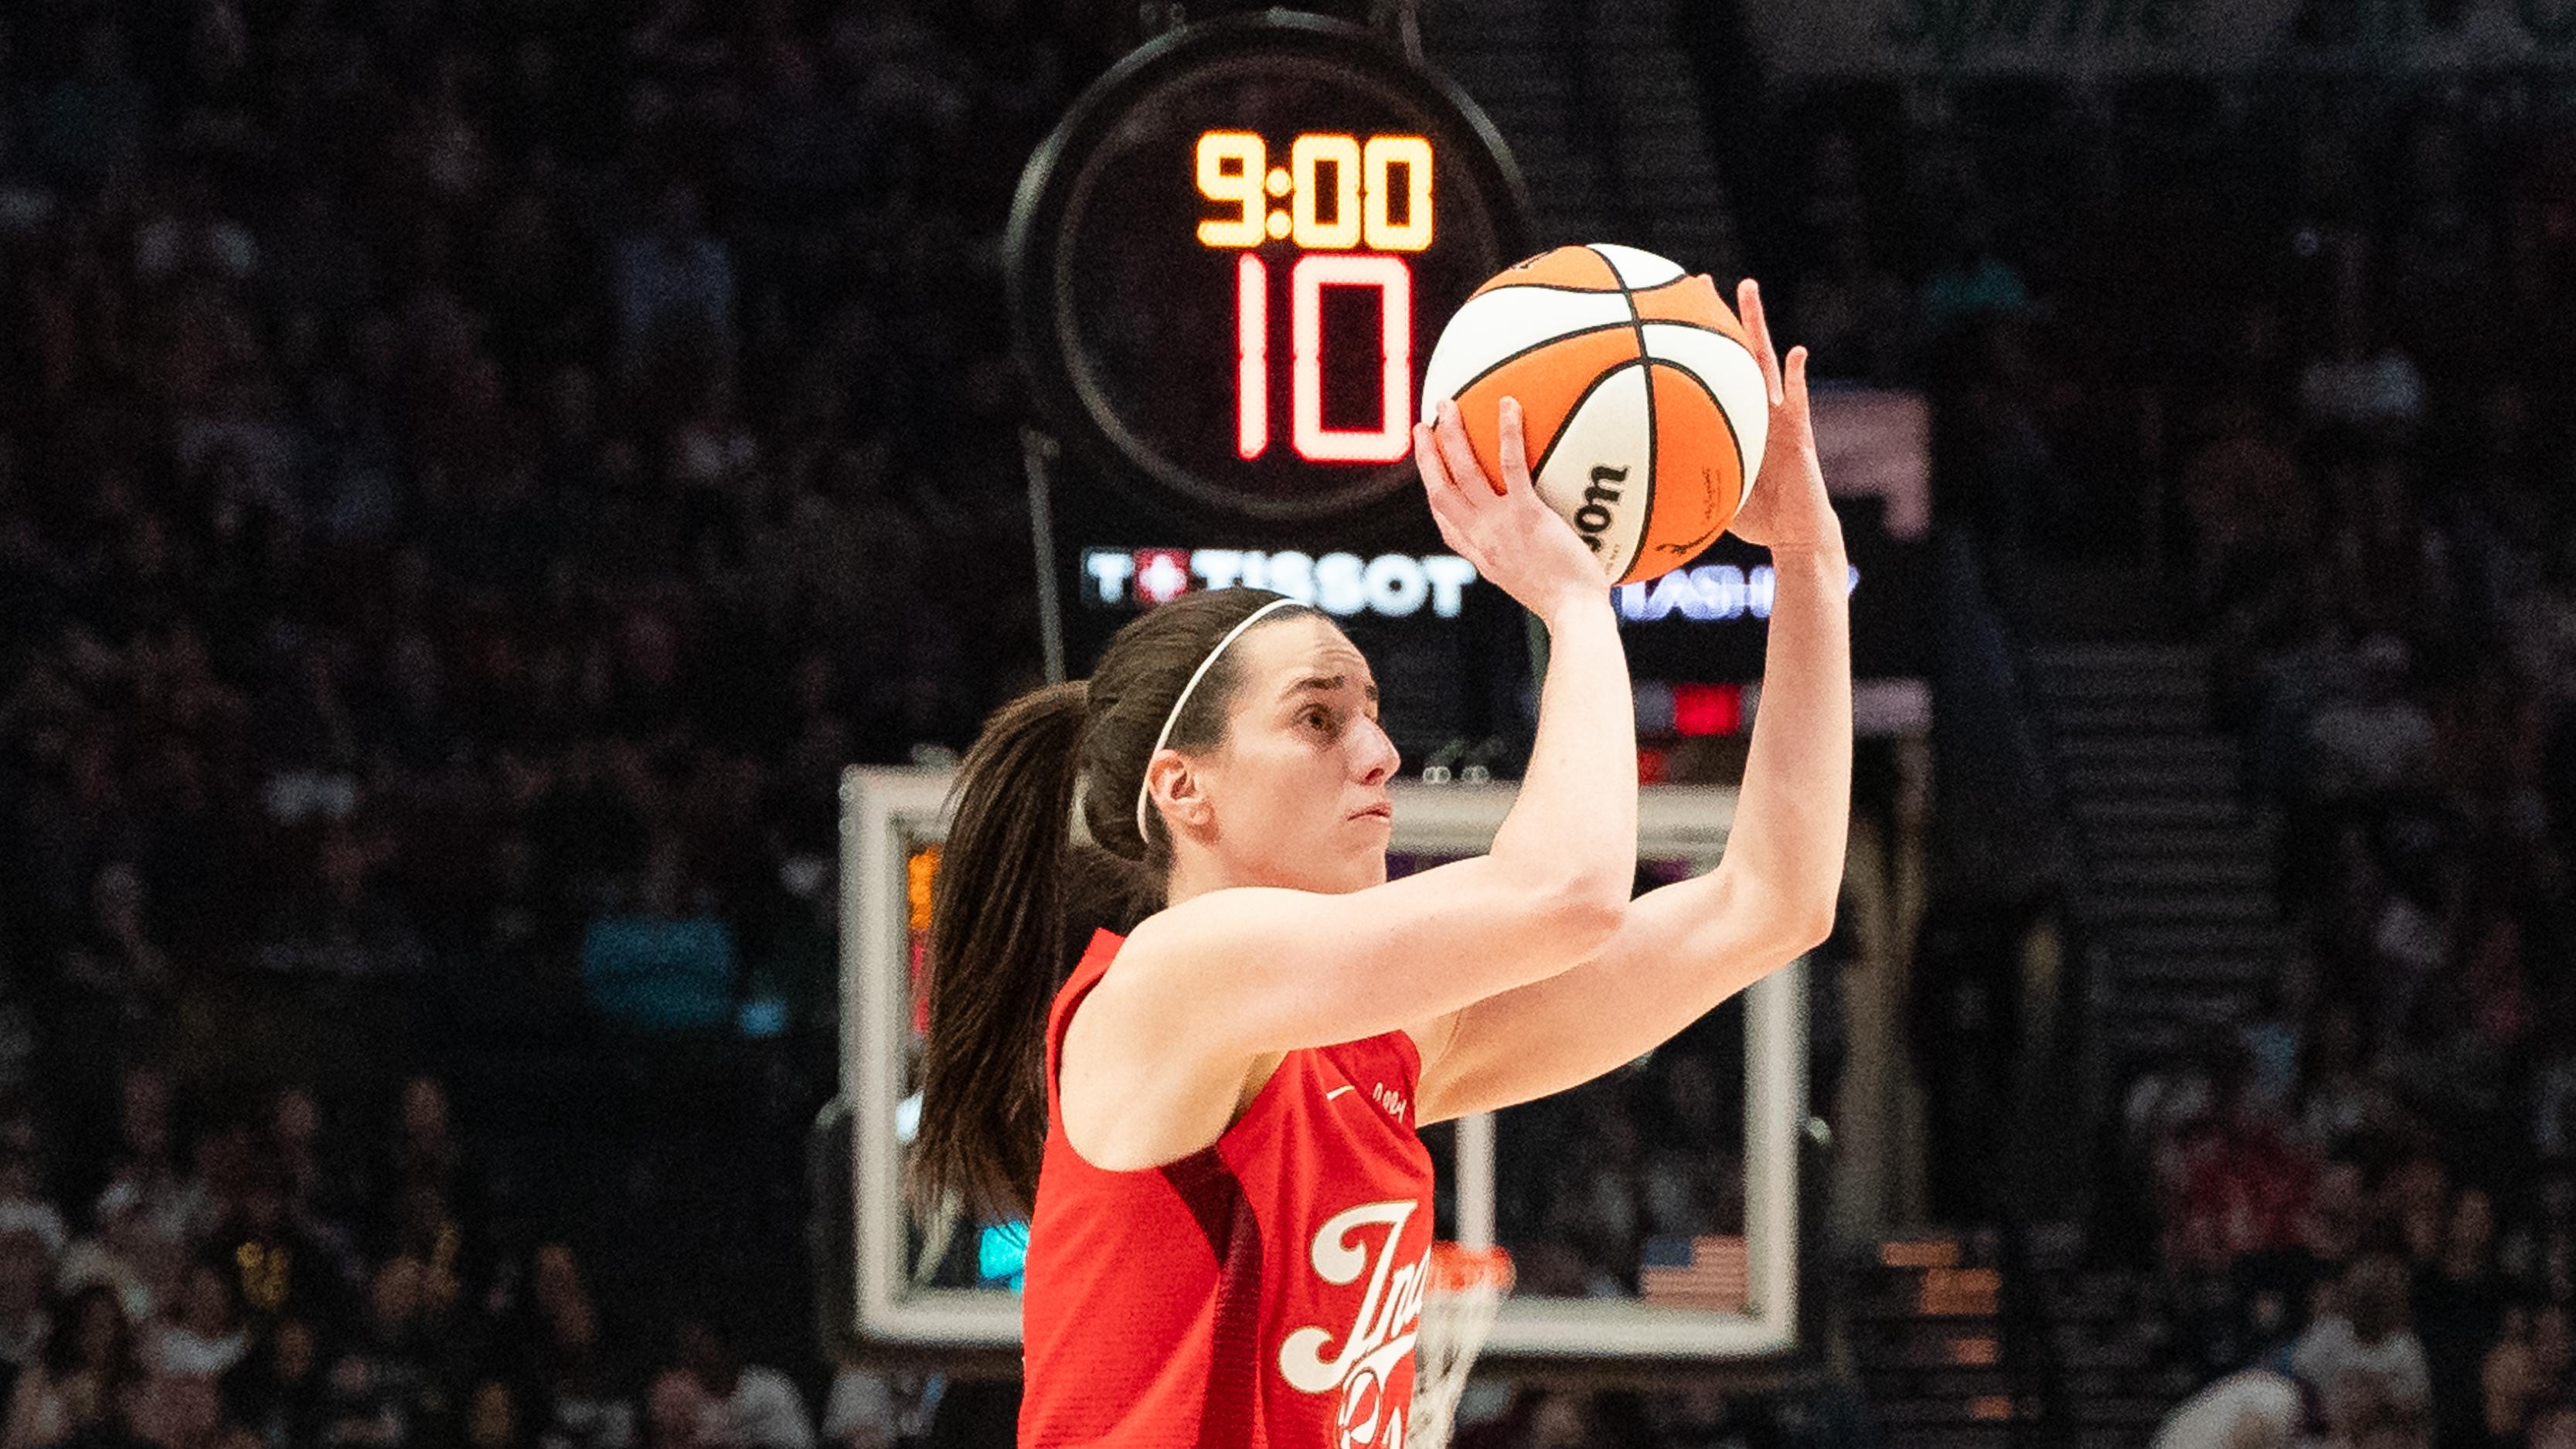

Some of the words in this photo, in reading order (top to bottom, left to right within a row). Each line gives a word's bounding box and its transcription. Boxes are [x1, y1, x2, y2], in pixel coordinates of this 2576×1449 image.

[1196, 130, 1434, 251] 9:00
[1237, 253, 1414, 462] 10
[1190, 549, 1478, 618] TISSOT
